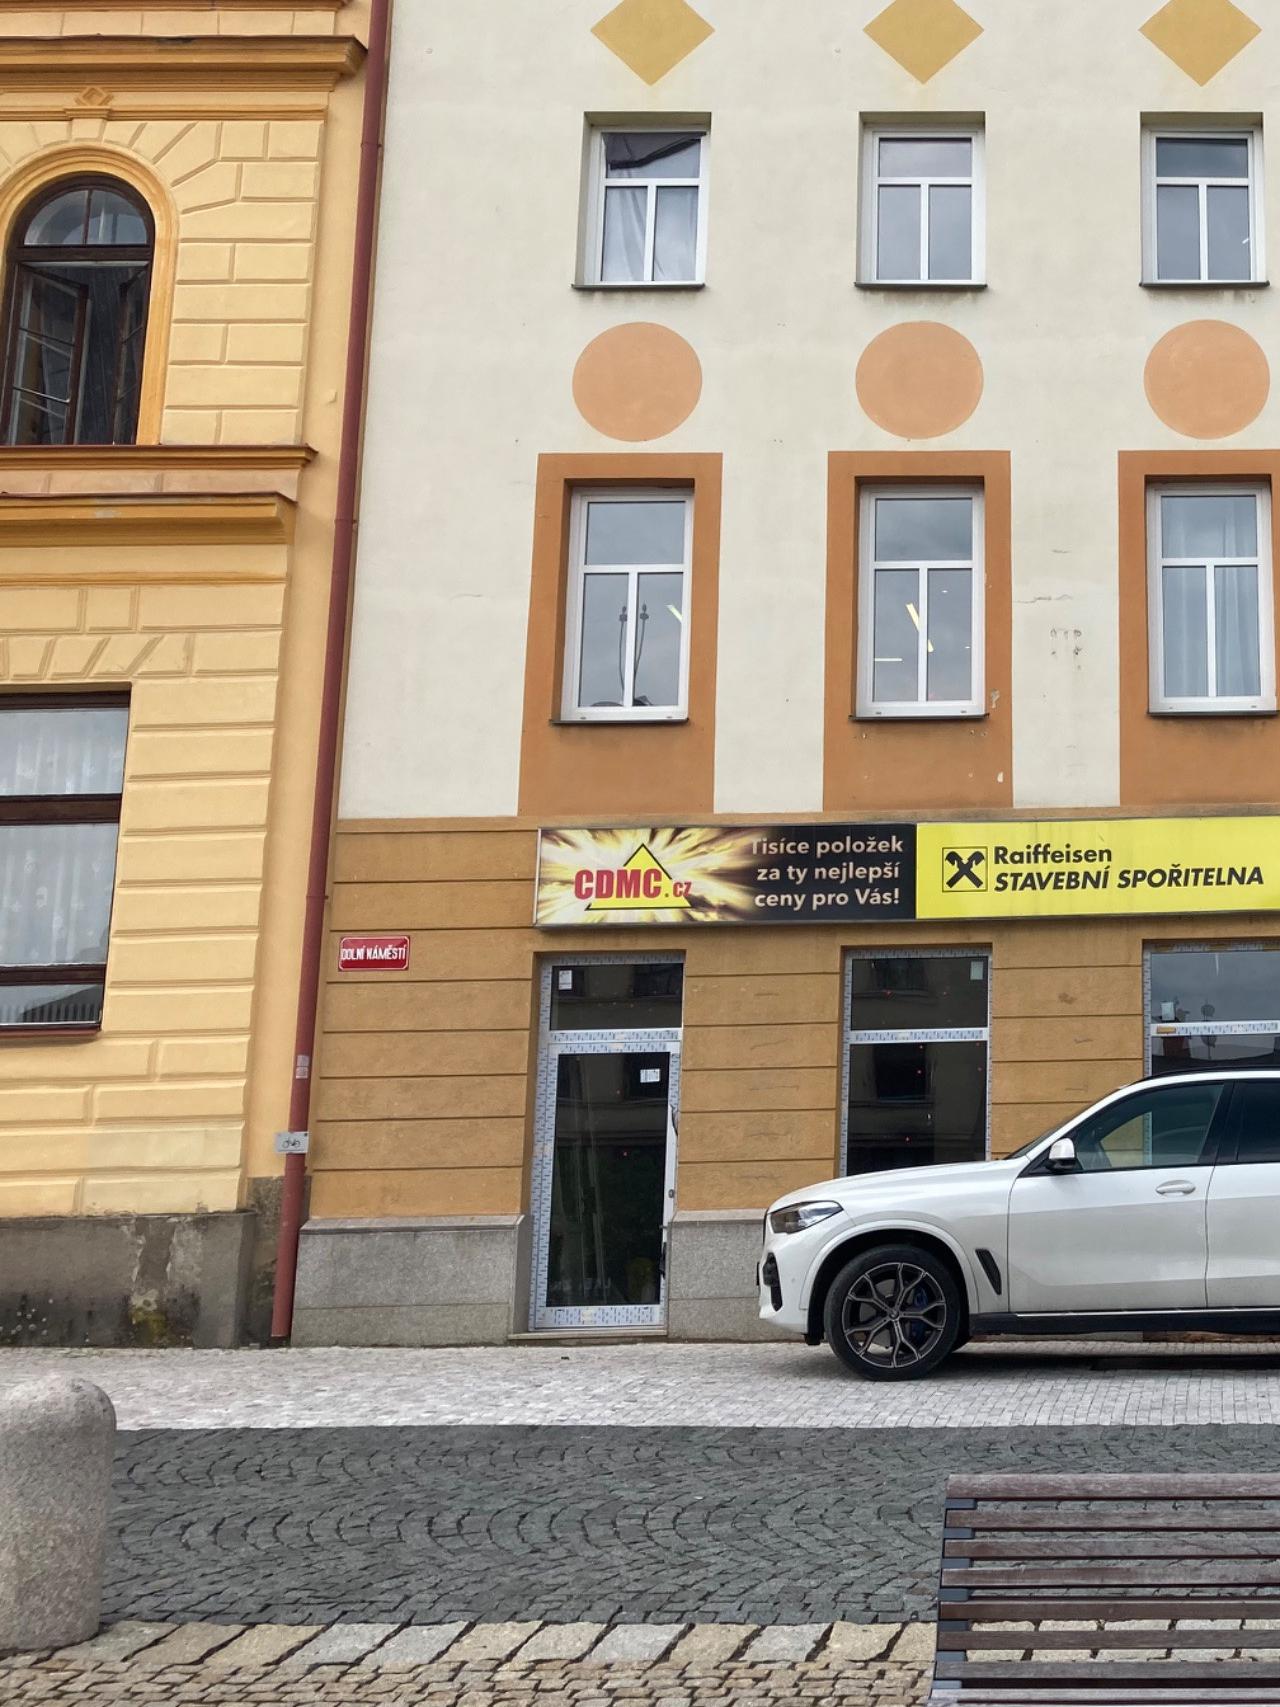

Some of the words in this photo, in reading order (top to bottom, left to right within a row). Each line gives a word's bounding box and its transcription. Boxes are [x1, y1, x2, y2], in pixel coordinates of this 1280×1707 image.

[750, 837, 810, 855] Tisíce
[815, 835, 904, 859] položek
[993, 843, 1113, 865] Raiffeisen
[757, 867, 781, 881] za
[786, 865, 808, 884] ty
[814, 861, 901, 884] nejlepší
[994, 865, 1111, 892] STAVEBNÍ
[1117, 863, 1264, 889] SPOŘITELNA
[754, 892, 807, 911] ceny
[812, 892, 849, 911] pro
[854, 887, 900, 905] Vás!
[341, 944, 366, 960] DOLNÍ
[366, 944, 407, 960] NÁMĚSTÍ
